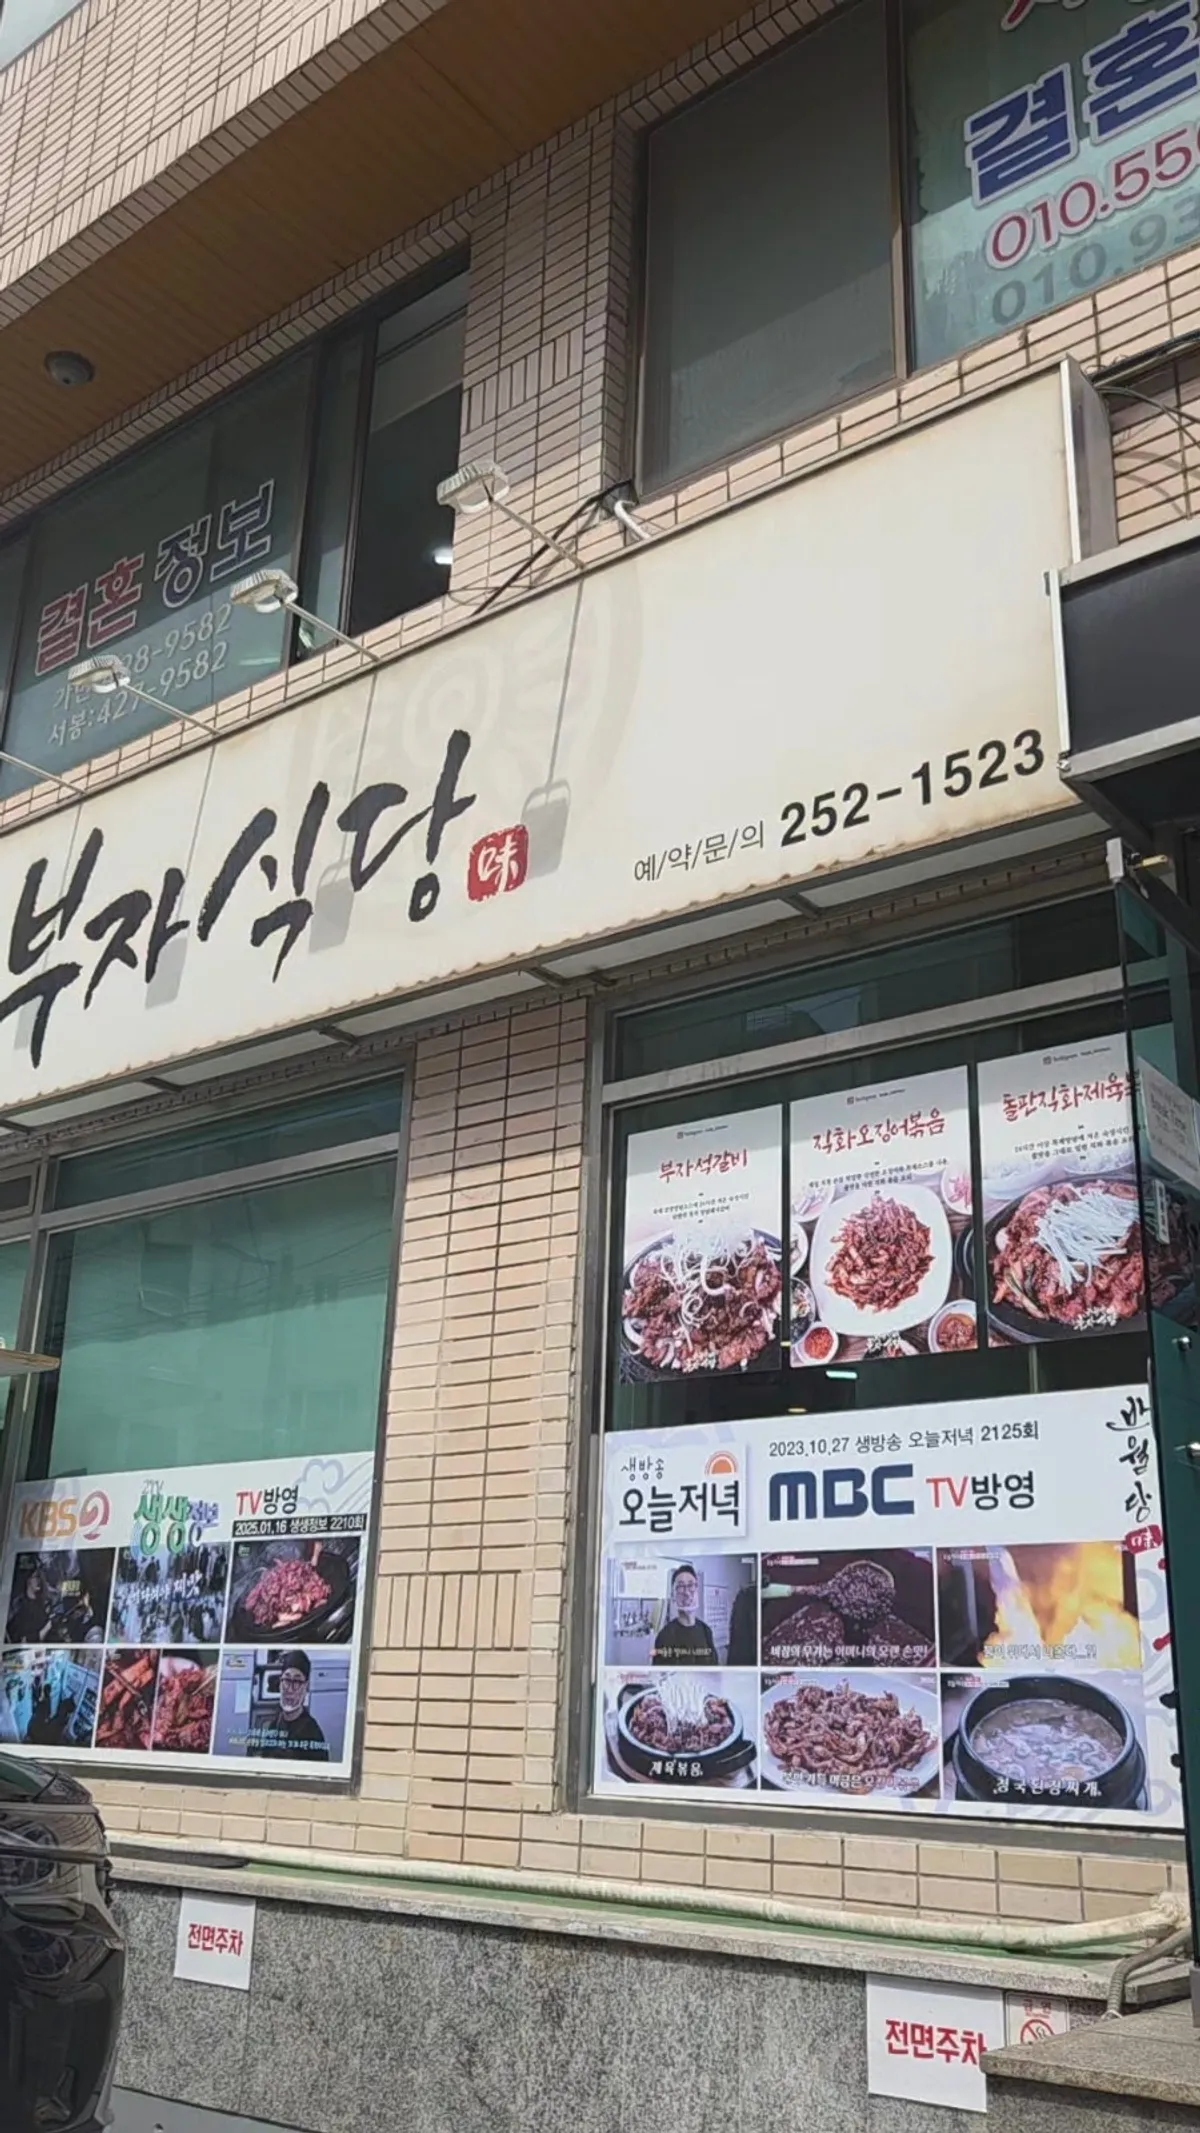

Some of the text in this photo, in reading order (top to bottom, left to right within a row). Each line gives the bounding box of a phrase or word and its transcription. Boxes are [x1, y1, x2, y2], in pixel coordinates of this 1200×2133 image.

[966, 1, 1200, 207] 결혼
[990, 126, 1200, 264] 010.55
[36, 479, 274, 676] 결혼 정보
[634, 728, 1045, 882] 예/약/문/의 252-1523
[474, 831, 524, 892] 味
[0, 729, 477, 1068] 부자식당
[813, 1107, 945, 1155] 직화오징어볶음
[659, 1148, 748, 1184] 부자석갈비
[769, 1420, 1039, 1458] 2023.10.27 생방송 오늘저녁 2125회
[621, 1456, 665, 1482] 생방송
[769, 1463, 915, 1522] MBC
[926, 1470, 1035, 1511] TV방영
[236, 1485, 299, 1516] TV방영
[619, 1480, 740, 1533] 오늘저녁
[234, 1514, 364, 1536] 2025.01.16 생생정보 2210회
[188, 1923, 243, 1956] 전면주차
[885, 2019, 987, 2065] 전면주차
